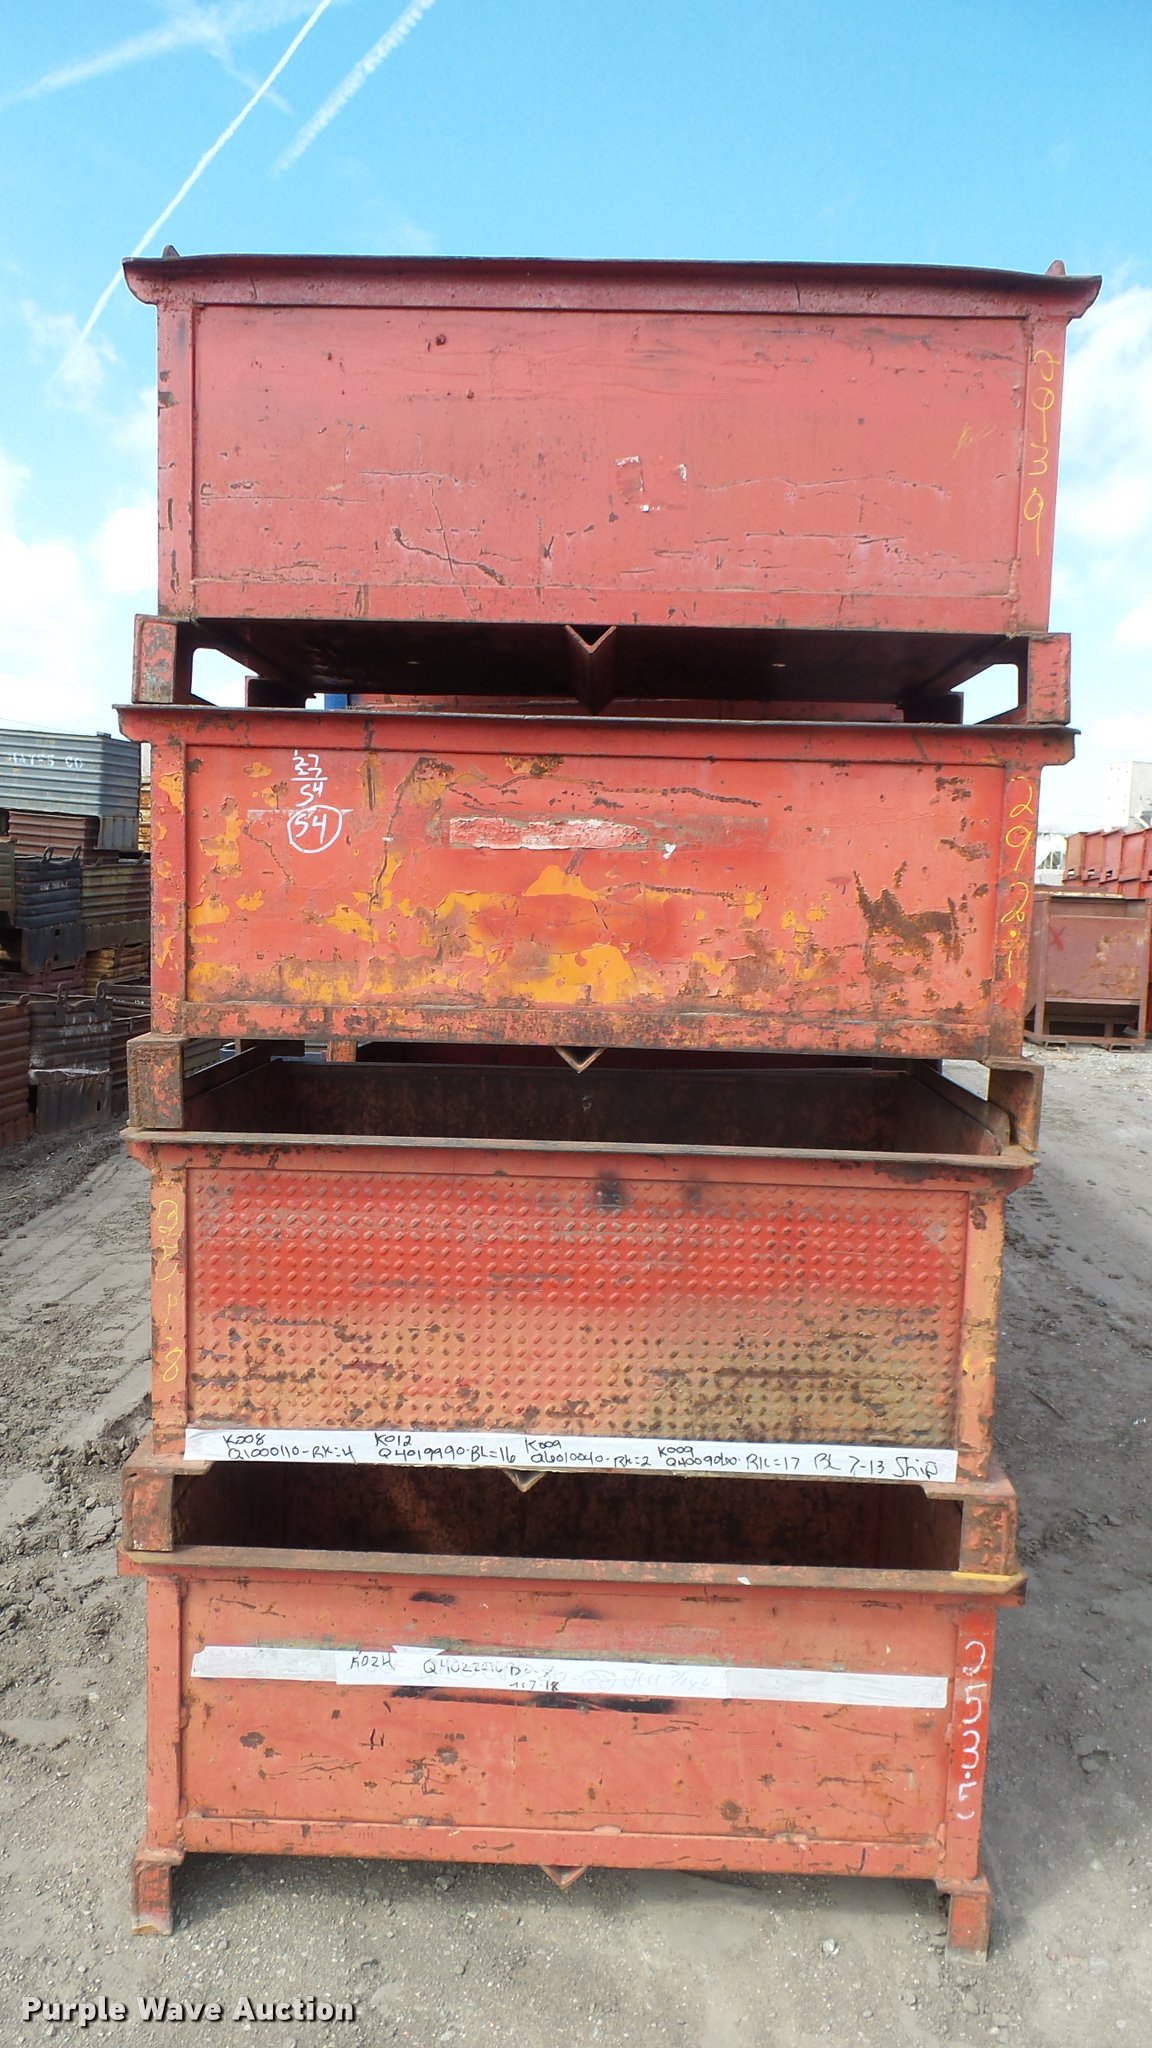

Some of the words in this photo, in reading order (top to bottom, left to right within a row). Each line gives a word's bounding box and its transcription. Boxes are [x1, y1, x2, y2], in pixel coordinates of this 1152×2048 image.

[296, 780, 324, 807] 54
[294, 813, 327, 844] 54
[374, 1432, 412, 1447] K012
